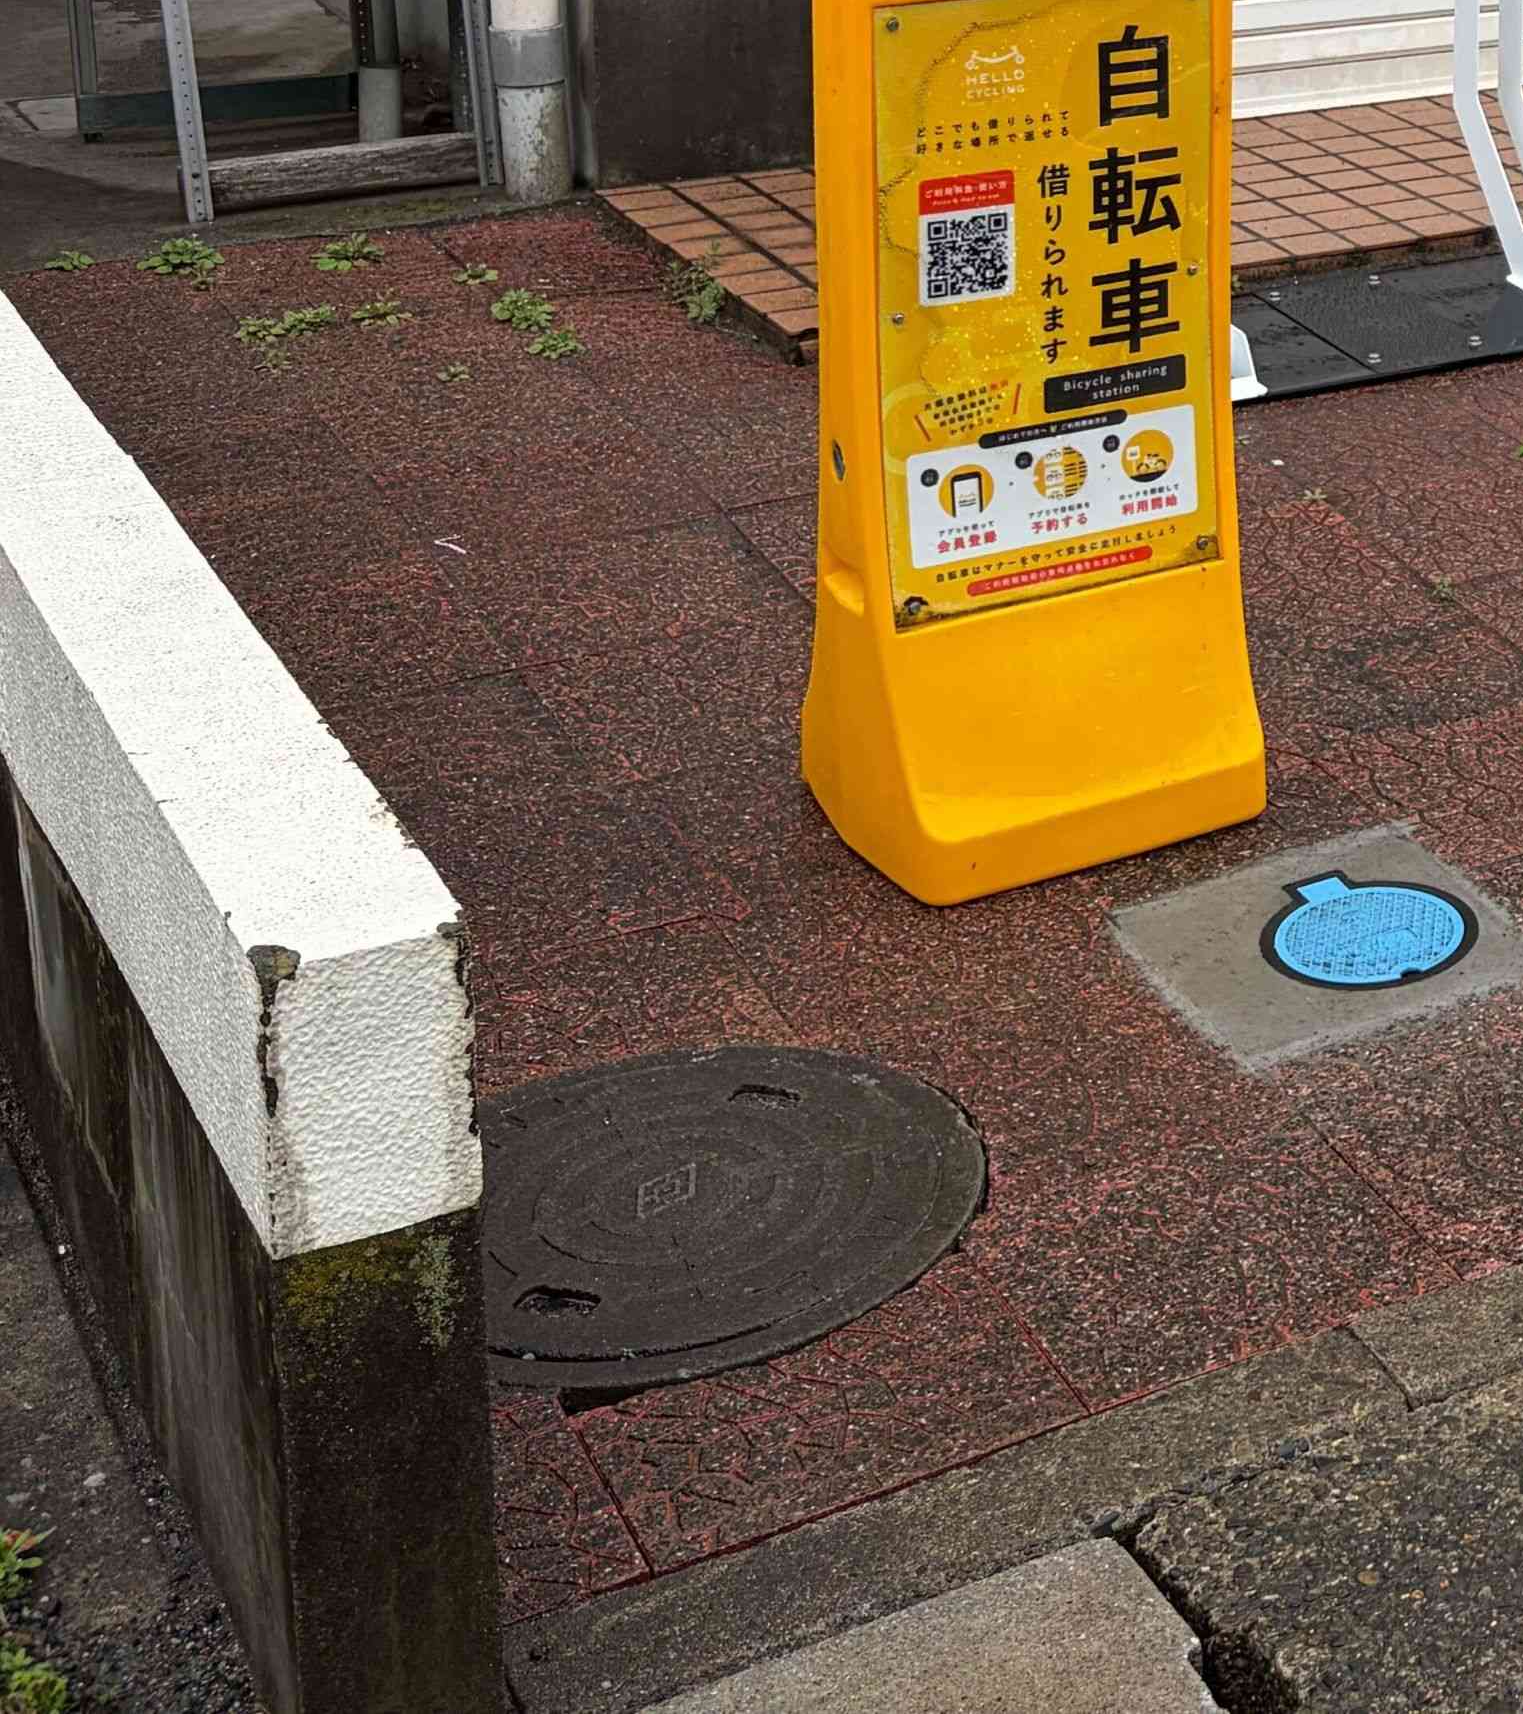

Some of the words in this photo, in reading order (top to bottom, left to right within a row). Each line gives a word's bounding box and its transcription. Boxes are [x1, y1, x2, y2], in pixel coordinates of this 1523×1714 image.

[966, 69, 1025, 86] HELLO
[965, 84, 1025, 100] CYCLING
[1088, 24, 1183, 354] 自転車
[1036, 162, 1072, 365] 借りられます
[1063, 373, 1113, 392] Bicycle
[1119, 363, 1169, 383] sharing
[1092, 383, 1141, 401] station
[1030, 512, 1089, 535] 予約する
[936, 529, 999, 554] 会員登録
